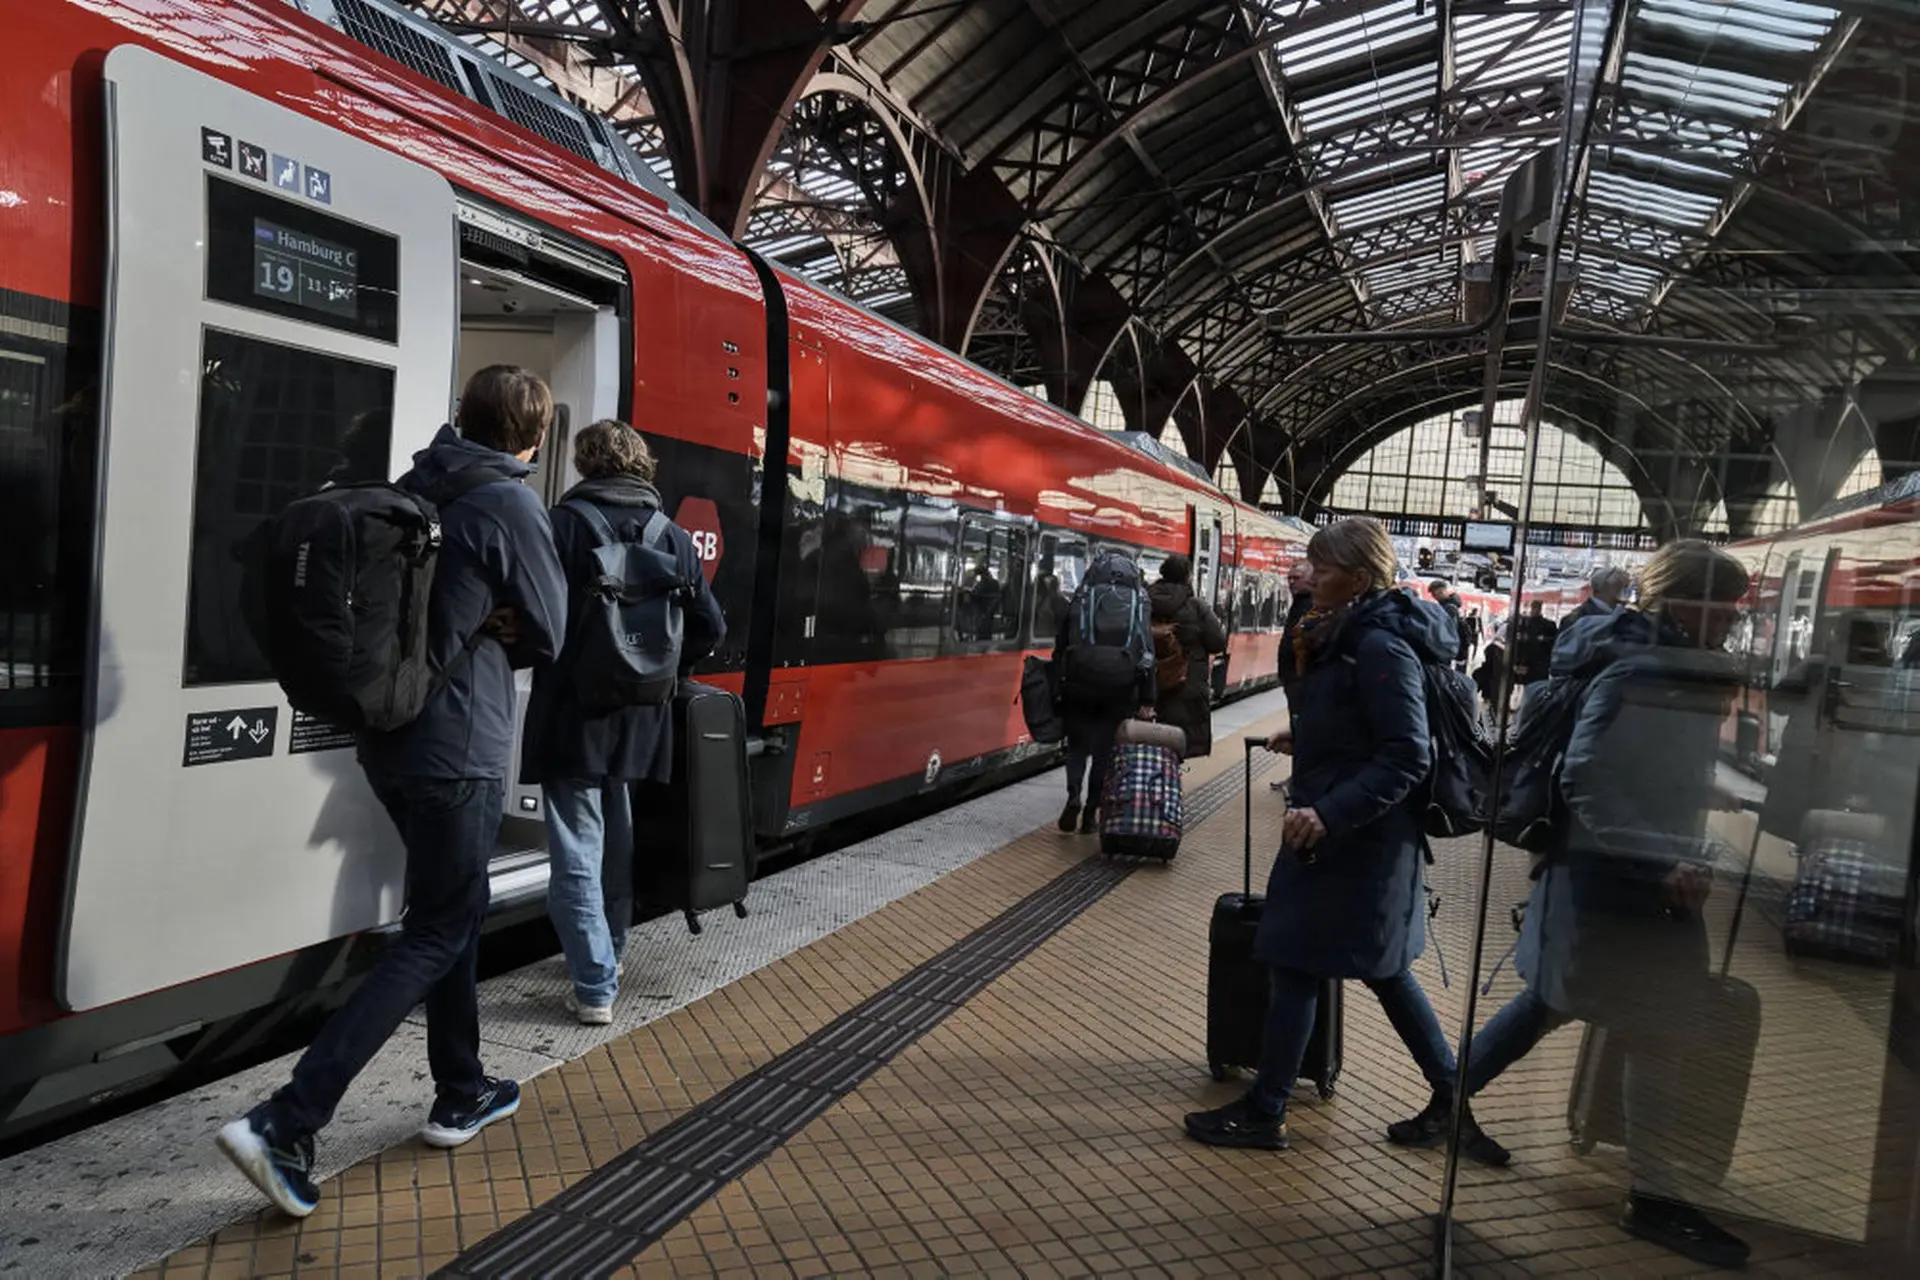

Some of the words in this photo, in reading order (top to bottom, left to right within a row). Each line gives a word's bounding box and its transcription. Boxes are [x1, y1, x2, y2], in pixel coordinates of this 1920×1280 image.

[278, 230, 343, 266] Hamburg
[260, 262, 294, 293] 19
[683, 528, 717, 561] SB
[294, 541, 310, 588] THULE
